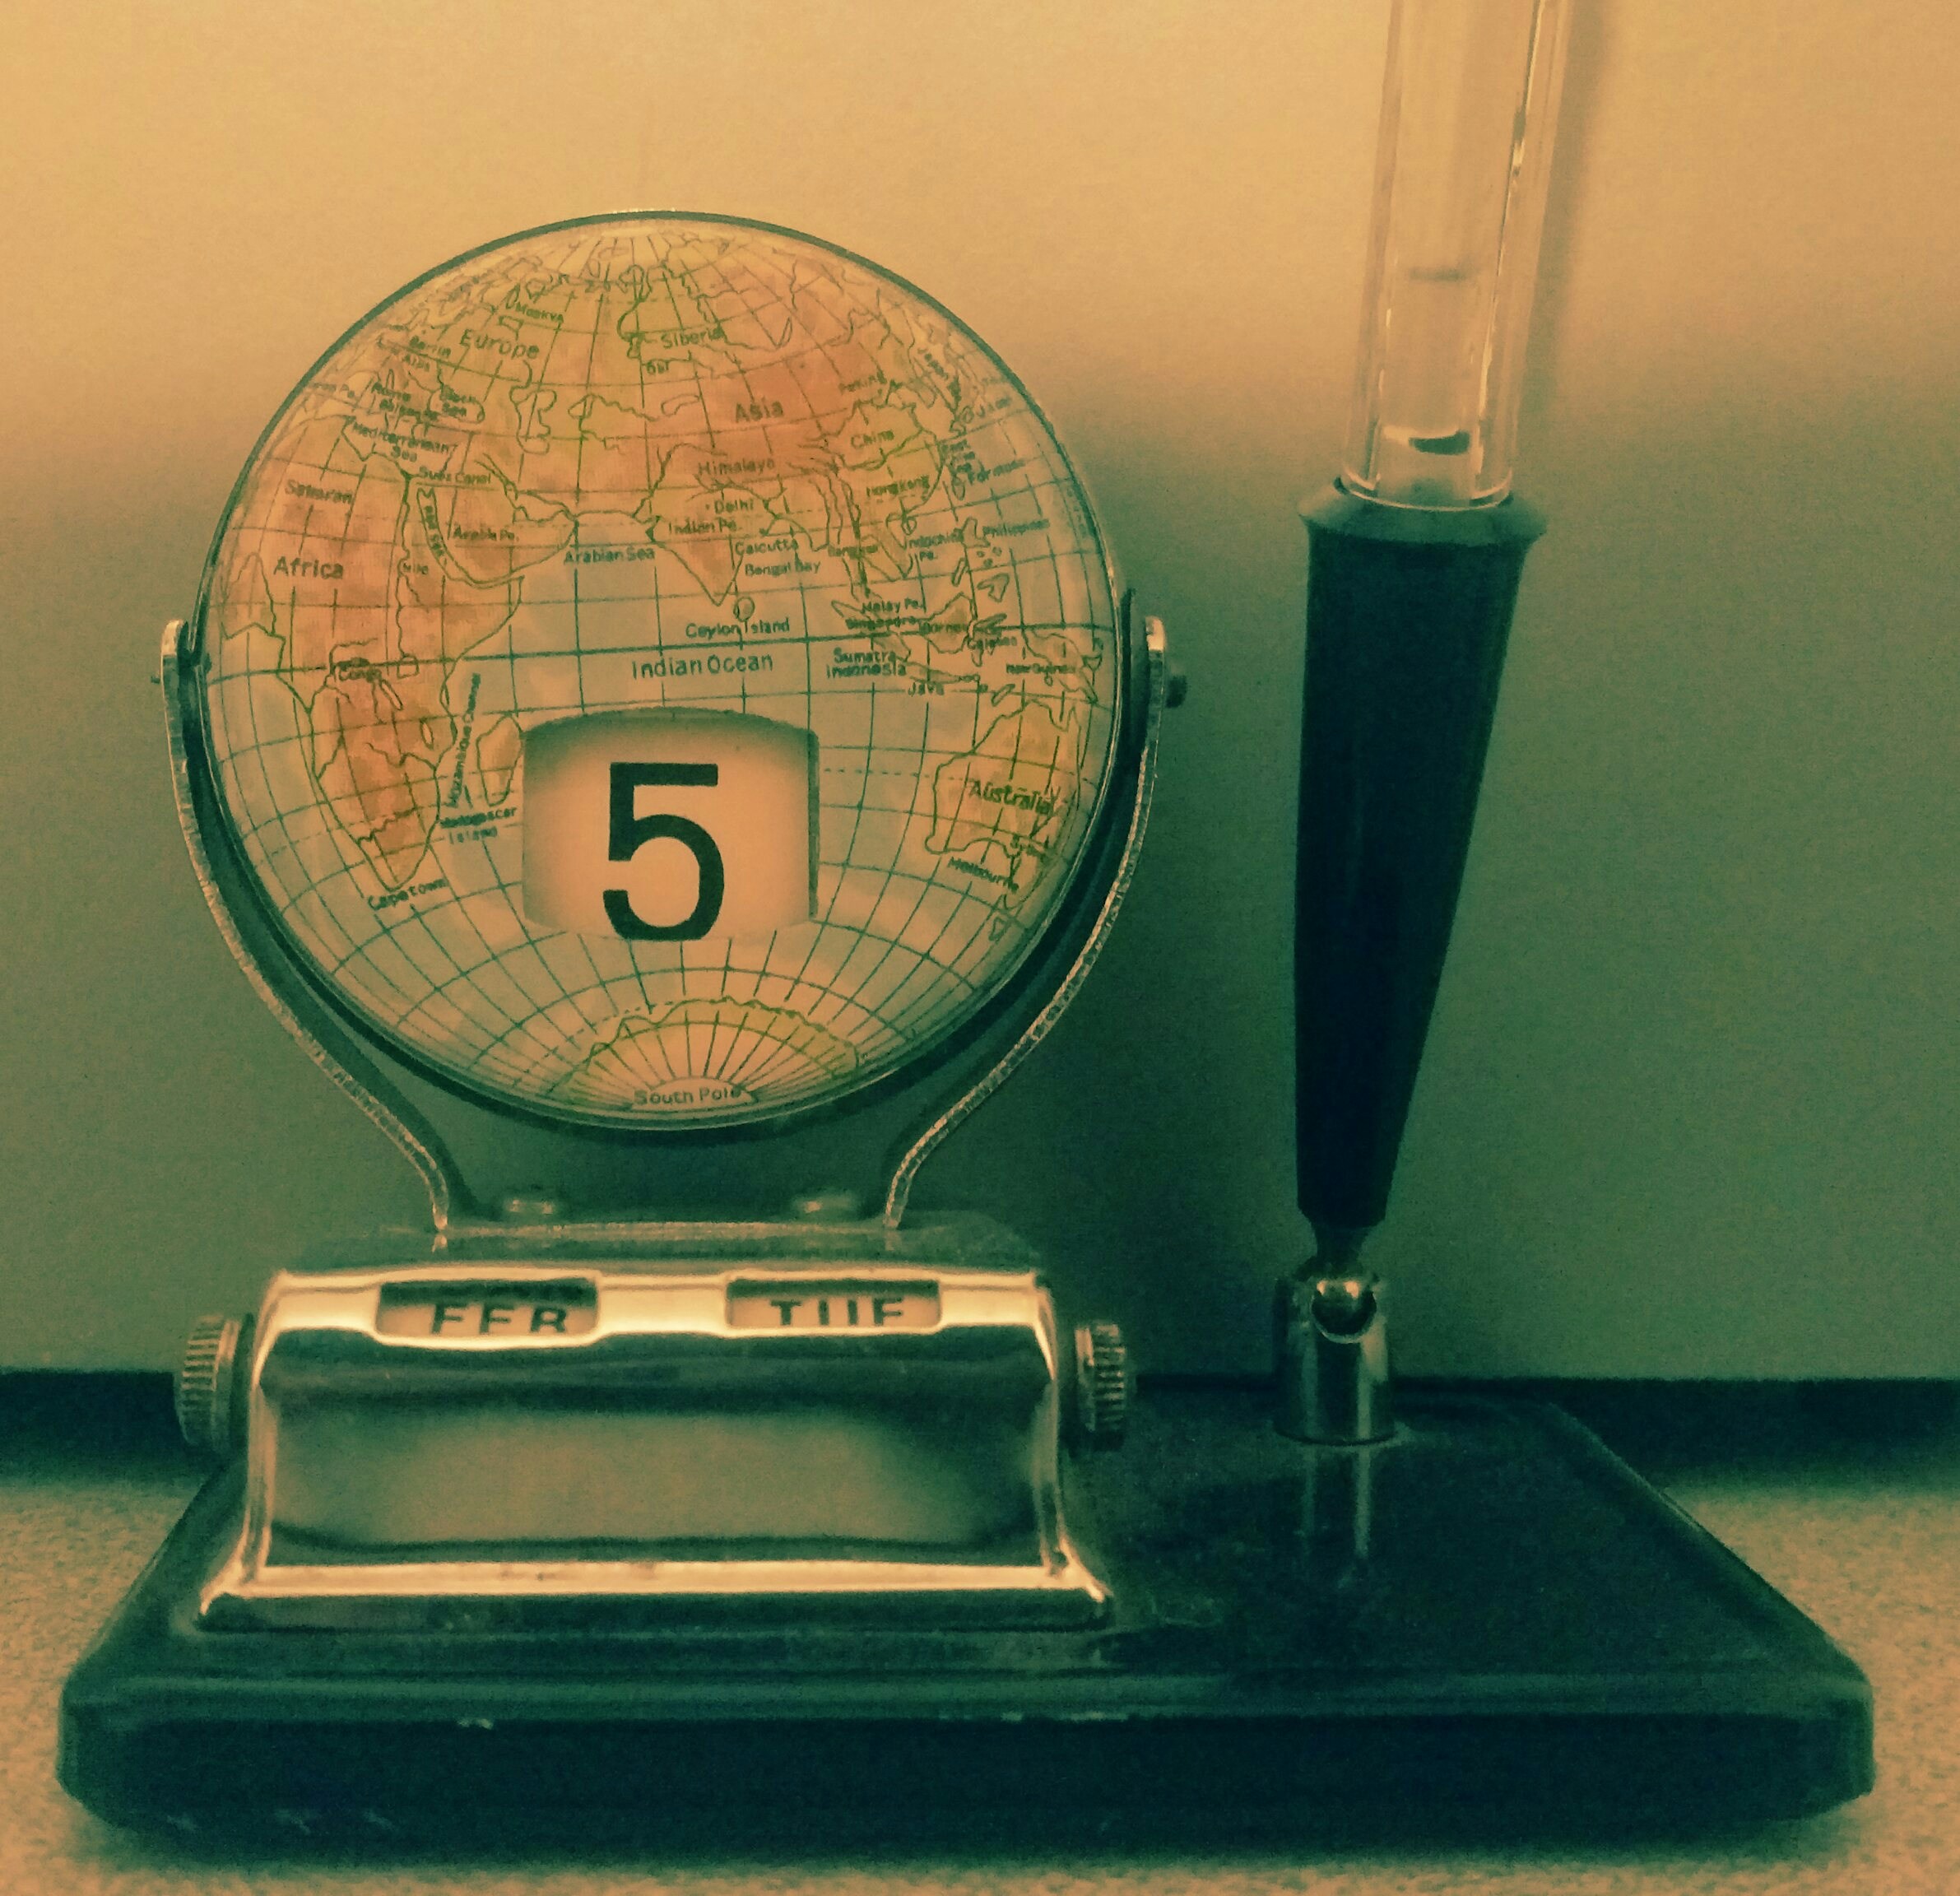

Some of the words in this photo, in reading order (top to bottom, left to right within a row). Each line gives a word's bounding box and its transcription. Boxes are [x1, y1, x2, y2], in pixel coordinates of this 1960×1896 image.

[459, 328, 540, 359] Europe
[736, 397, 783, 423] Asia
[714, 499, 754, 515] Delhi
[564, 548, 621, 565] Arabian
[627, 546, 656, 561] Sea
[735, 537, 799, 555] Calcutta
[273, 555, 344, 579] Africa
[744, 616, 790, 634] Island
[632, 657, 703, 680] Indian
[707, 653, 773, 673] Ocean
[602, 761, 725, 941] 5
[634, 1088, 694, 1105] South
[699, 1085, 744, 1101] Pole
